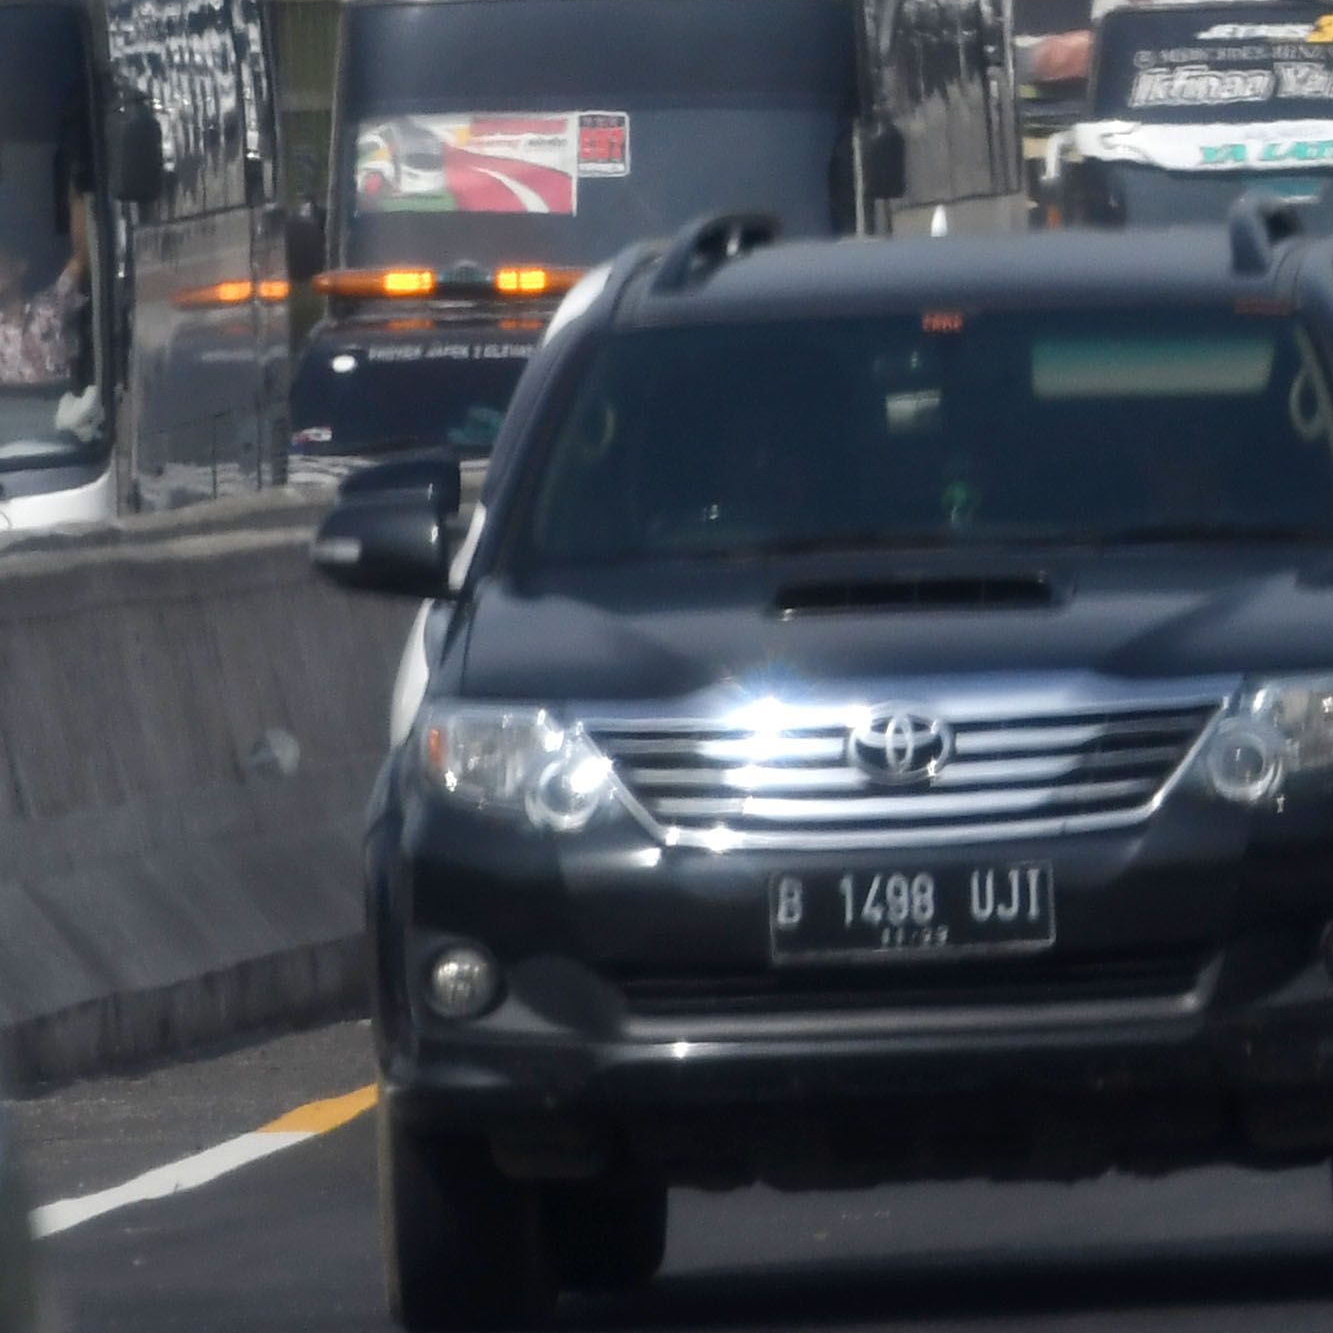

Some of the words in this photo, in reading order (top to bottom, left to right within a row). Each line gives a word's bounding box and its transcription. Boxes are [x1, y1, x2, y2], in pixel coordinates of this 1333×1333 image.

[777, 874, 802, 927] B
[839, 870, 936, 926] 1498
[970, 867, 1041, 921] UJI
